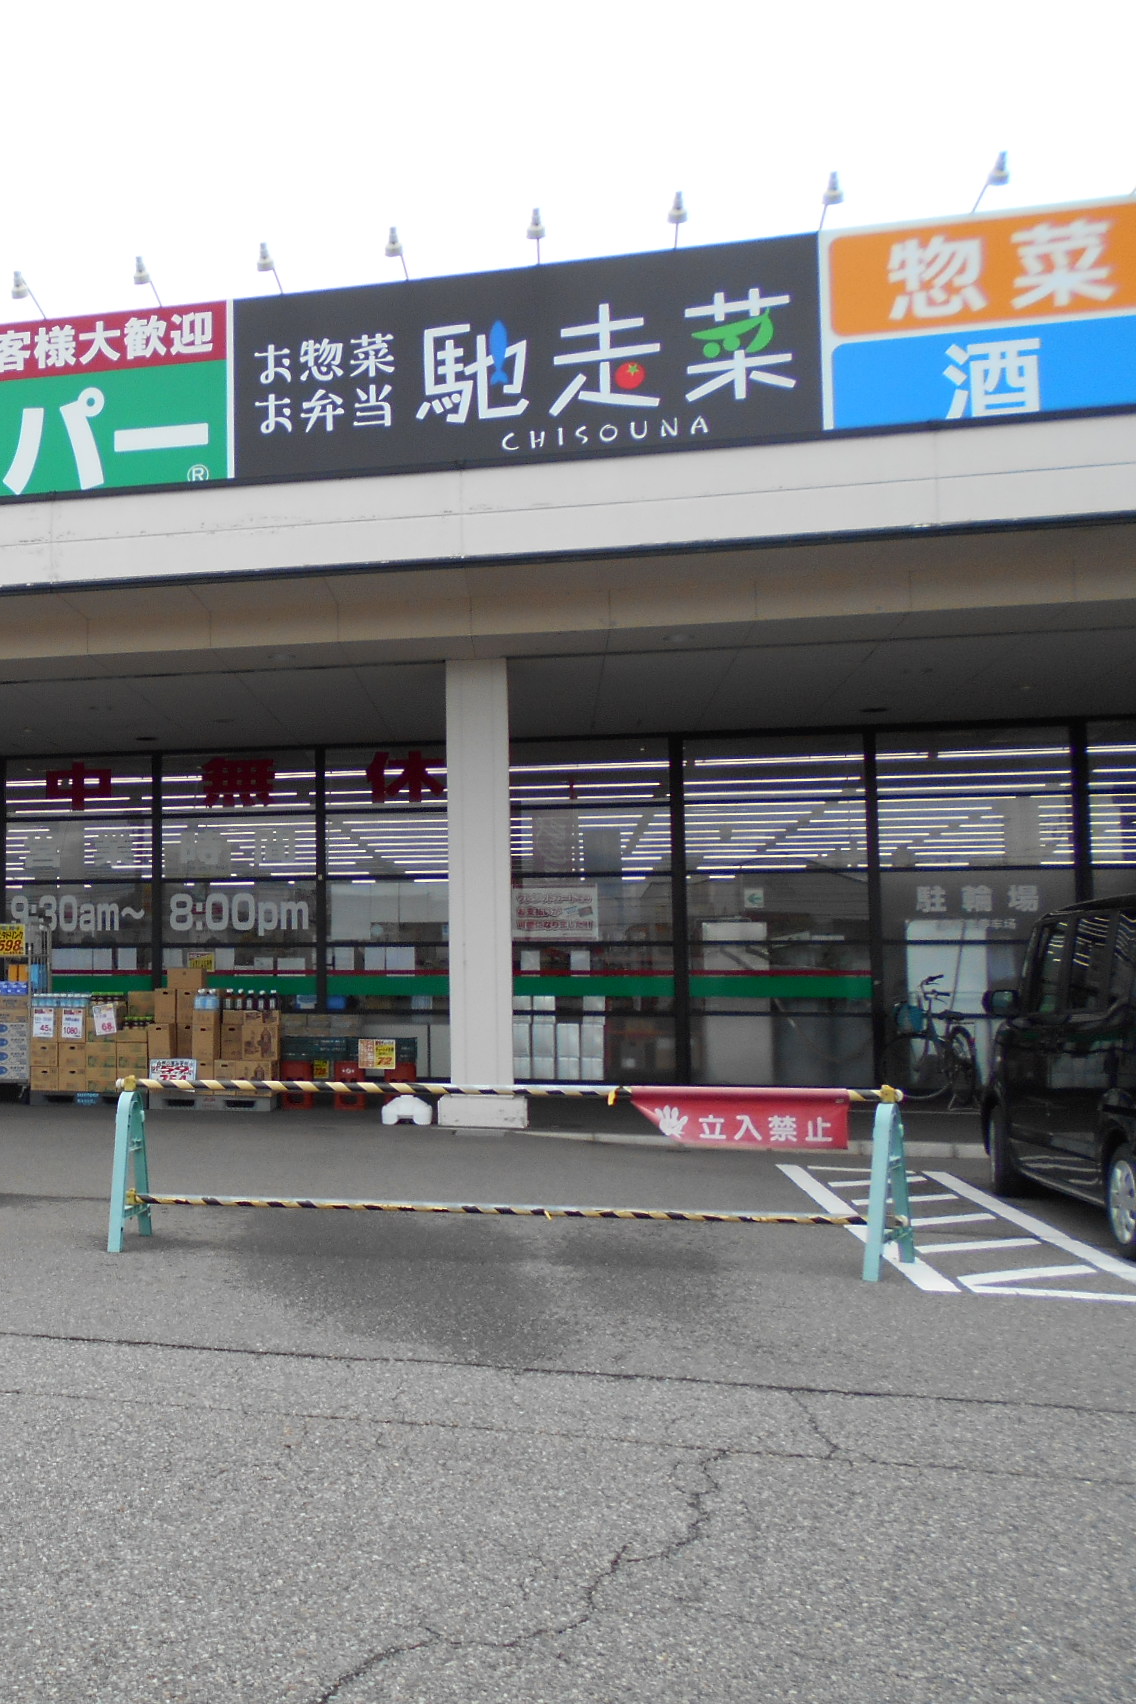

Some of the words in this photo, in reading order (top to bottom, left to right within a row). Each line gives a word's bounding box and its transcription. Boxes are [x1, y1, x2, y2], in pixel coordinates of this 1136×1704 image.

[886, 218, 1118, 321] 惣菜
[254, 333, 396, 385] お惣菜
[416, 288, 797, 424] 馳走菜
[942, 337, 1042, 420] 酒
[254, 384, 393, 434] お弁当
[501, 415, 710, 451] CHISOUNA
[169, 892, 309, 936] 8:00pm
[698, 1114, 833, 1143] 立入禁止
